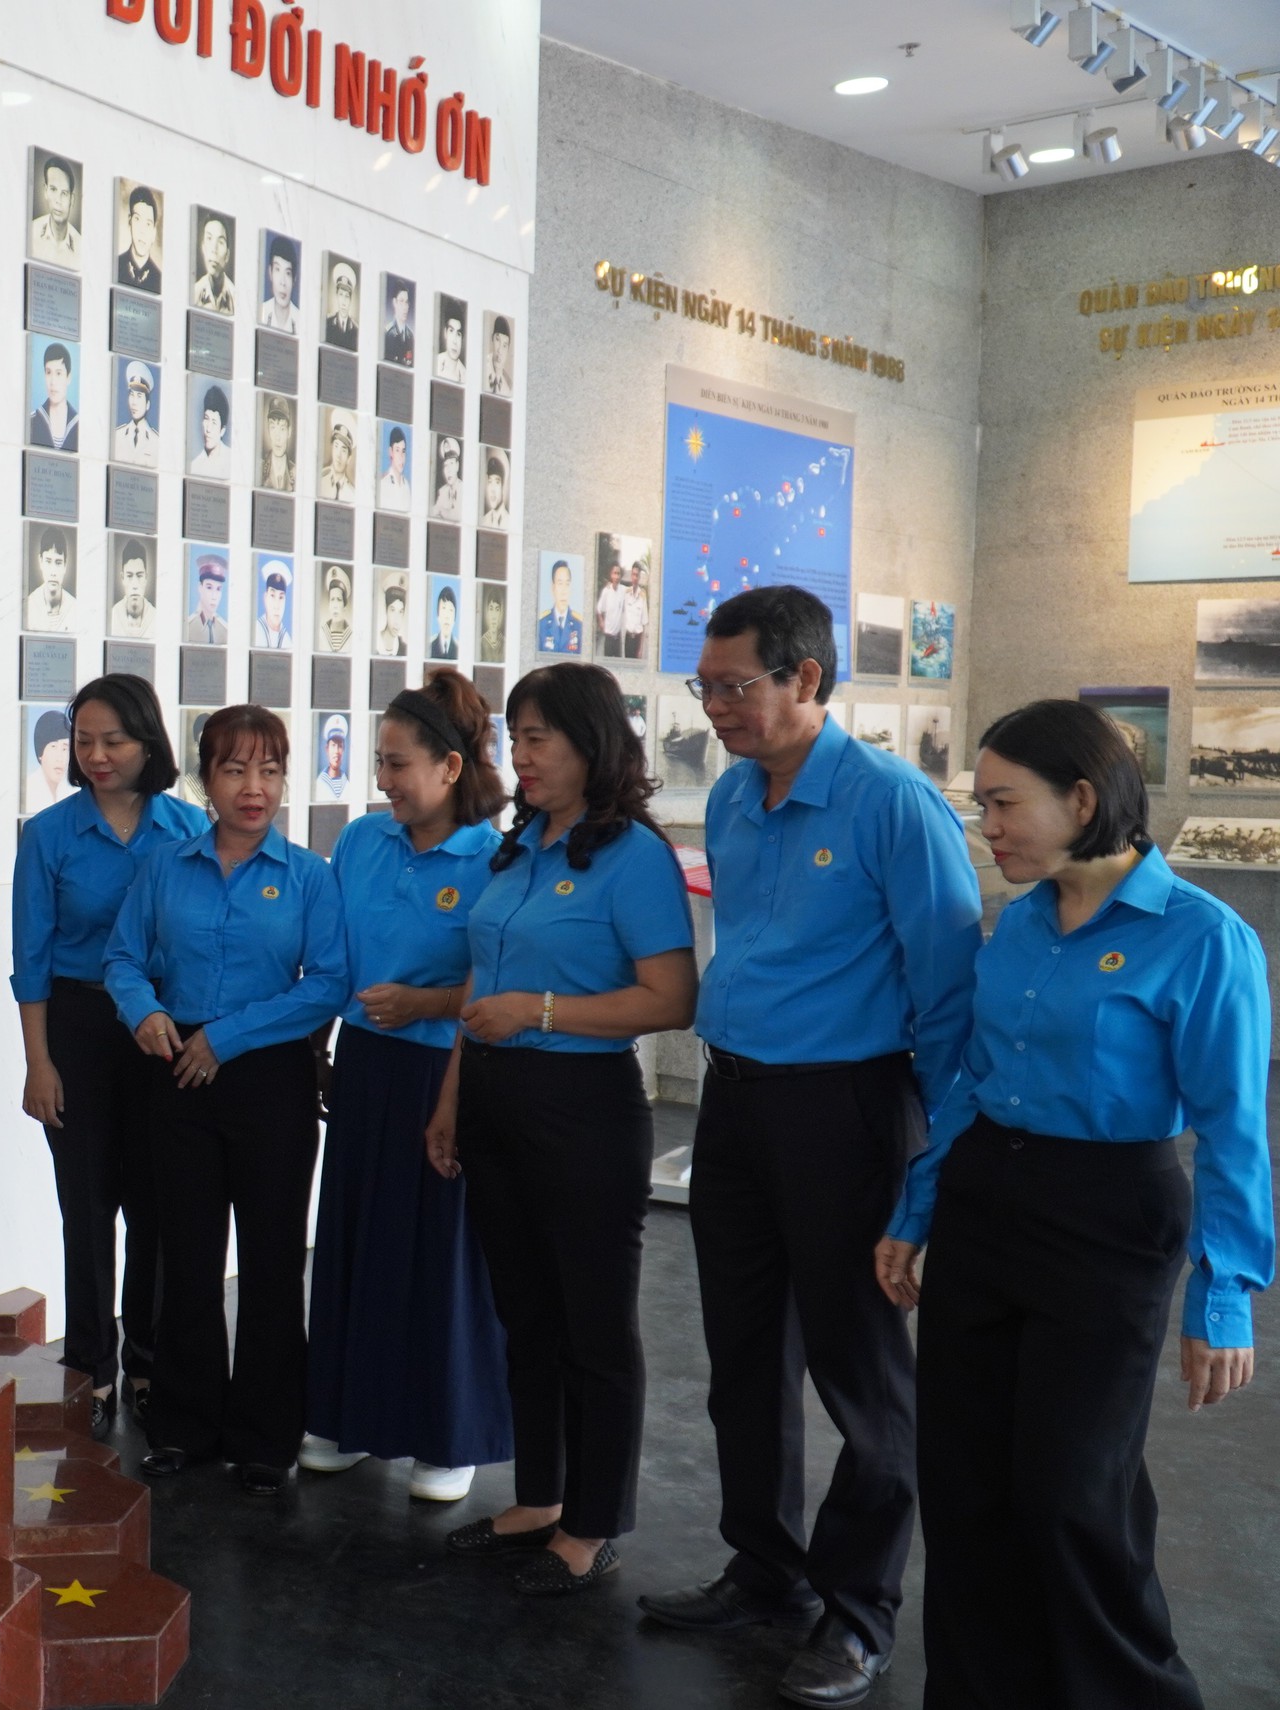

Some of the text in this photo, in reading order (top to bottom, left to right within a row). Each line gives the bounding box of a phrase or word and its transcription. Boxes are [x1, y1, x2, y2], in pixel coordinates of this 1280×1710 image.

[230, 0, 322, 108] ĐỜI
[334, 42, 428, 154] NHỚ
[436, 91, 491, 187] ƠN
[682, 288, 732, 329] NGÀY
[736, 308, 756, 339] 14
[760, 314, 817, 357] THÁNG
